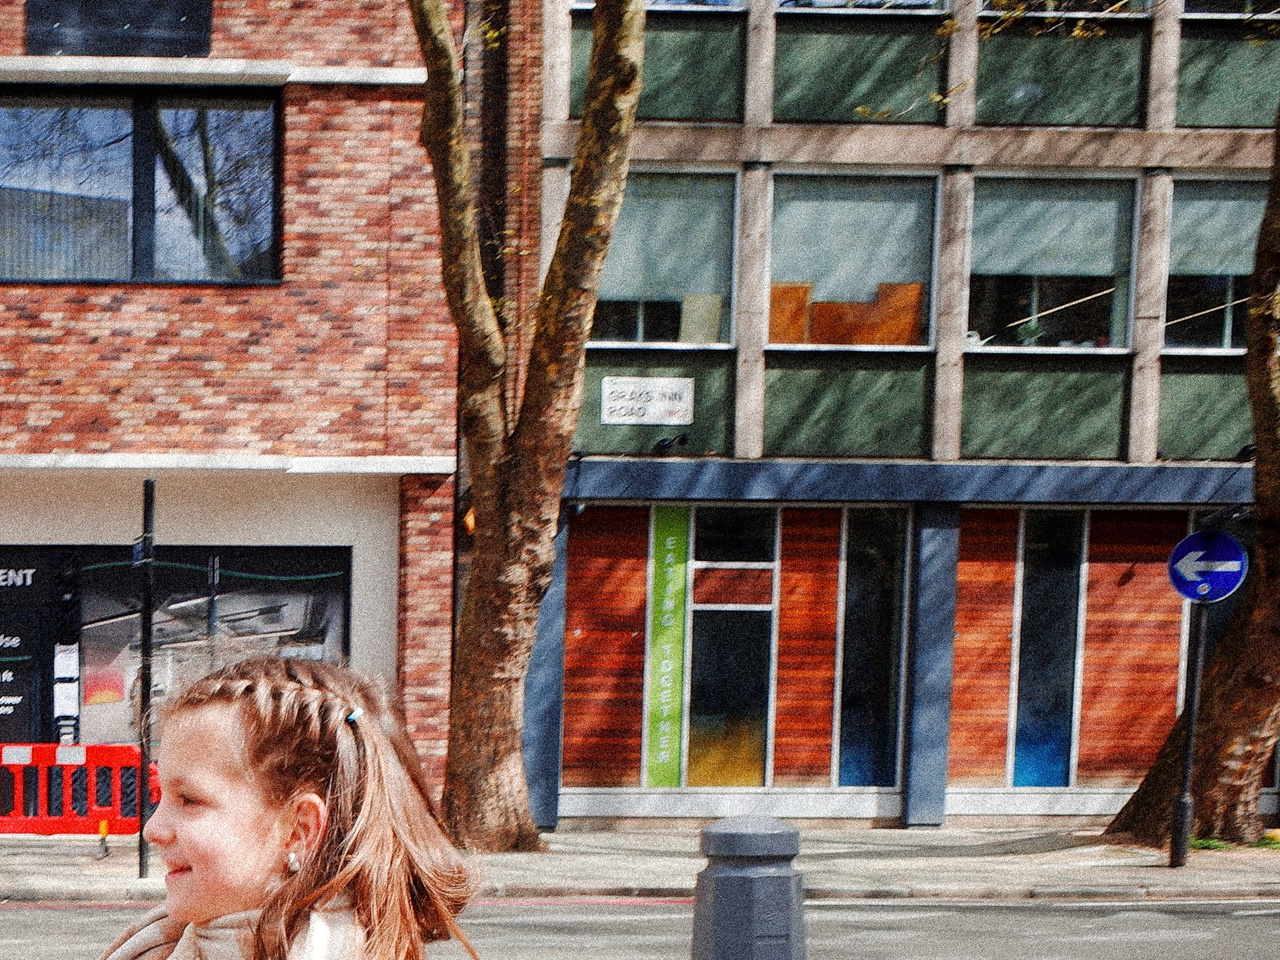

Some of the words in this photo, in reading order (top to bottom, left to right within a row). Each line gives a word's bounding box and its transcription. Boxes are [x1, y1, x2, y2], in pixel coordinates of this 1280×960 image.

[607, 405, 646, 418] ROAD
[659, 536, 677, 628] EATING
[1, 669, 14, 683] ft
[656, 643, 675, 764] TOGETHER
